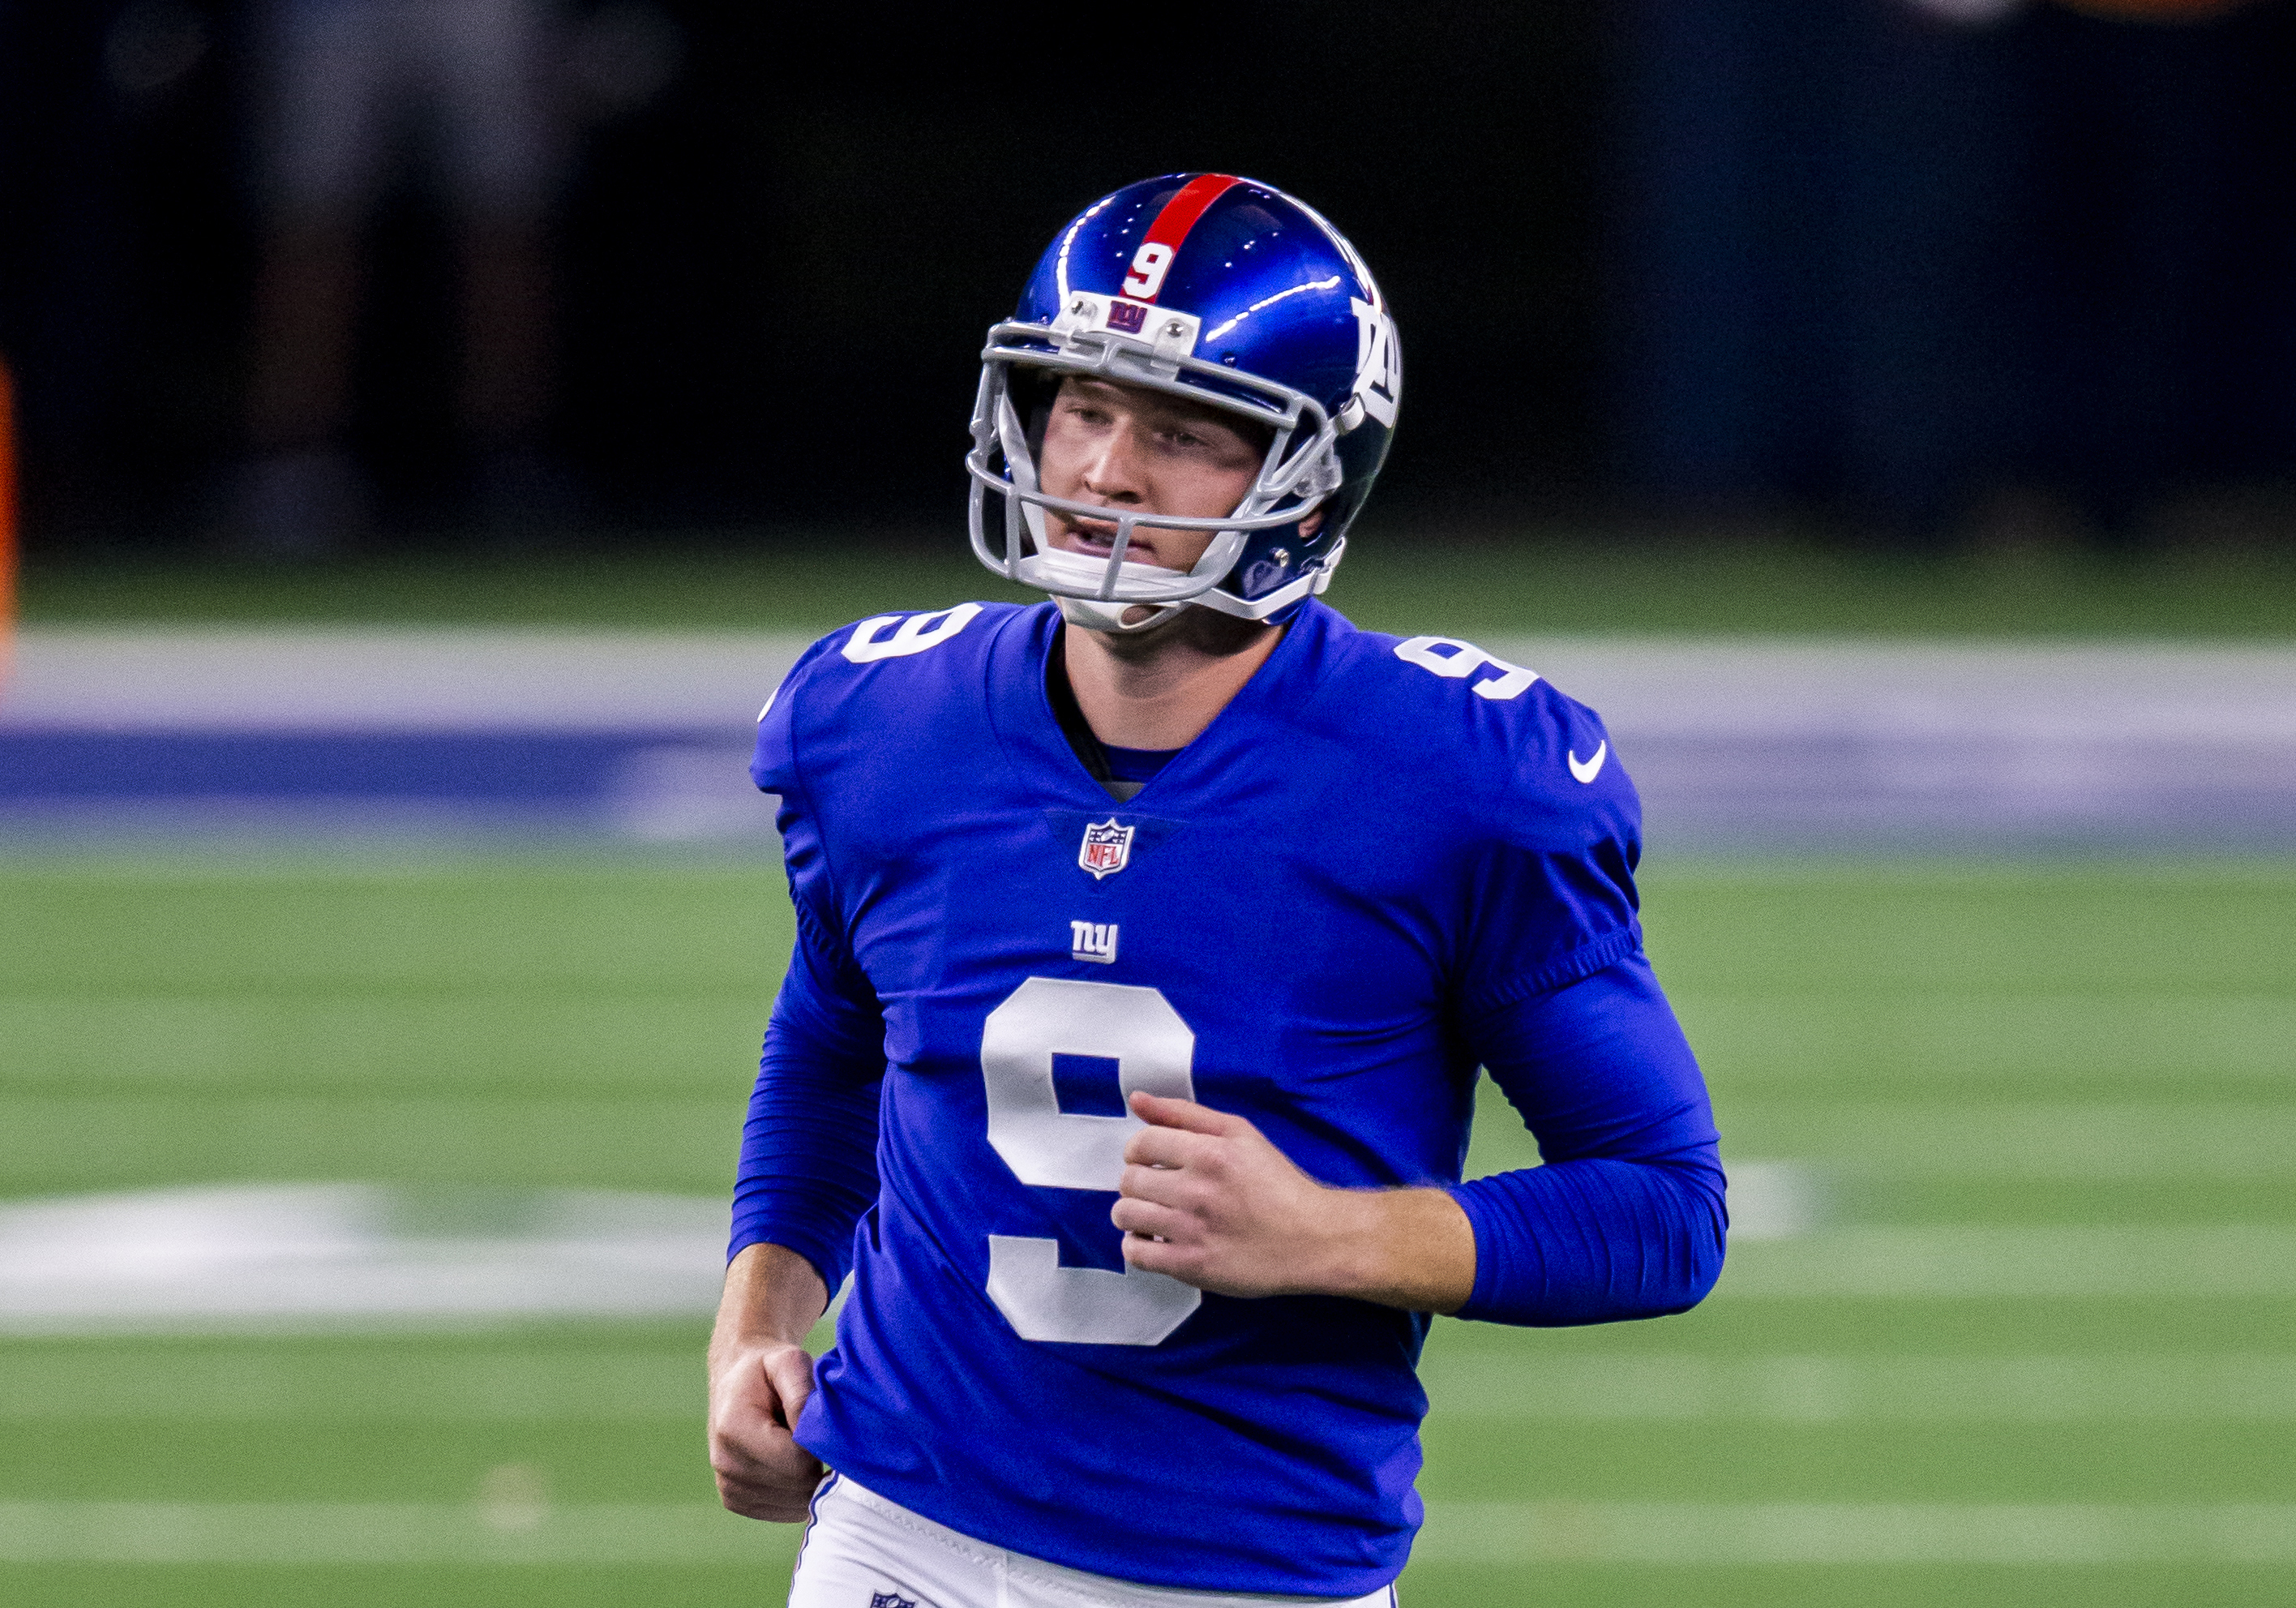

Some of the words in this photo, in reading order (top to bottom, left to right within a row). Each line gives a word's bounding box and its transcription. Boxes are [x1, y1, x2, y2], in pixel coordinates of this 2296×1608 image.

[1123, 242, 1174, 299] 9
[841, 602, 984, 663] 9
[1393, 636, 1541, 700] 9
[1087, 843, 1120, 867] NFL
[980, 976, 1202, 1346] 9
